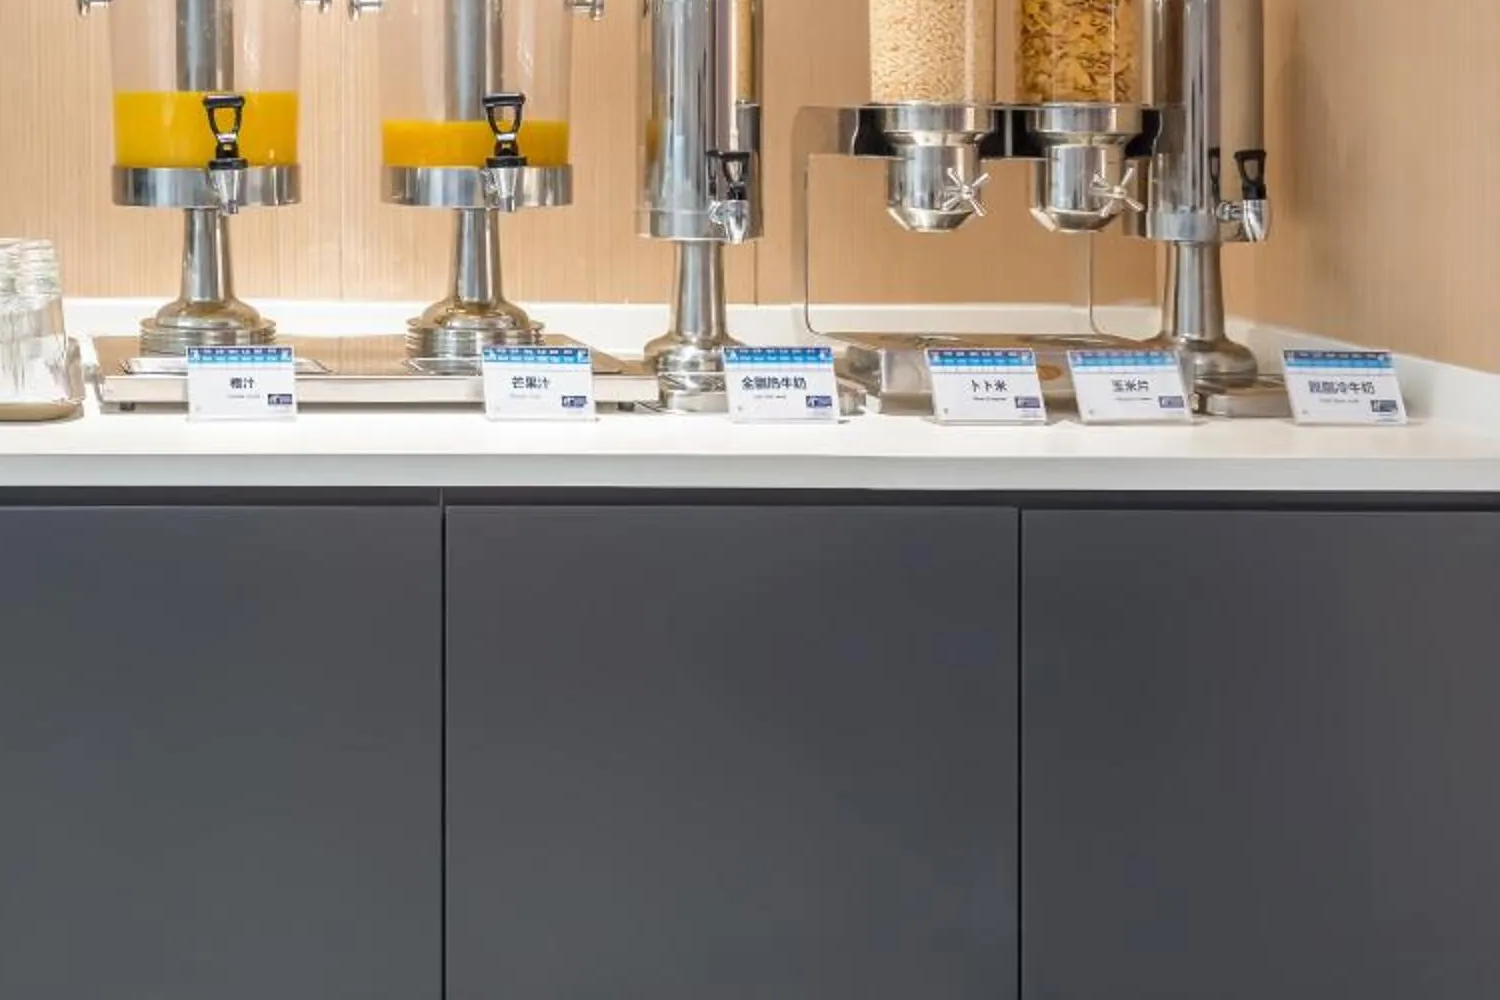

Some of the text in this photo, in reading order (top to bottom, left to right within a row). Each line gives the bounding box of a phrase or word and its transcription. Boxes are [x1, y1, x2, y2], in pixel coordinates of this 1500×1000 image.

[229, 376, 255, 389] 橙汁
[511, 375, 550, 390] 芒果汁
[1111, 379, 1149, 393] 玉米片
